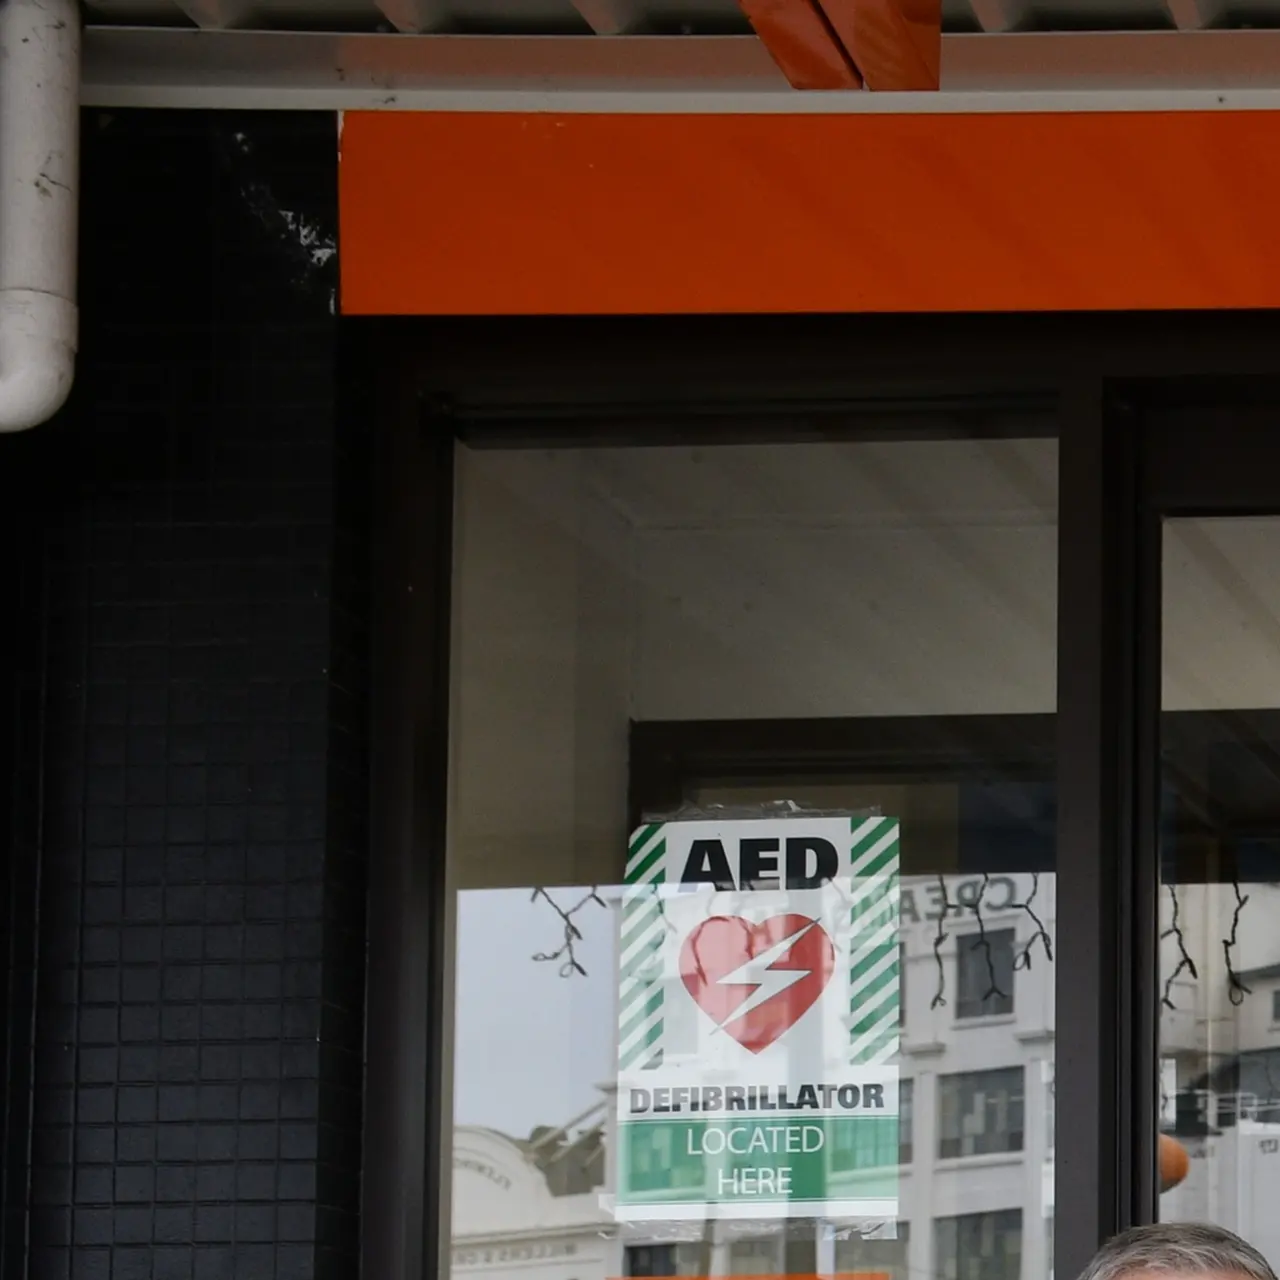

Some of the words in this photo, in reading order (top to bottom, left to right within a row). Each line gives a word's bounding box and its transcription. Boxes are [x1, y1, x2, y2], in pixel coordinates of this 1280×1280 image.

[678, 837, 839, 892] AED
[629, 1083, 885, 1113] DEFIBRILLATOR
[687, 1126, 824, 1155] LOCATED
[717, 1167, 793, 1195] HERE
